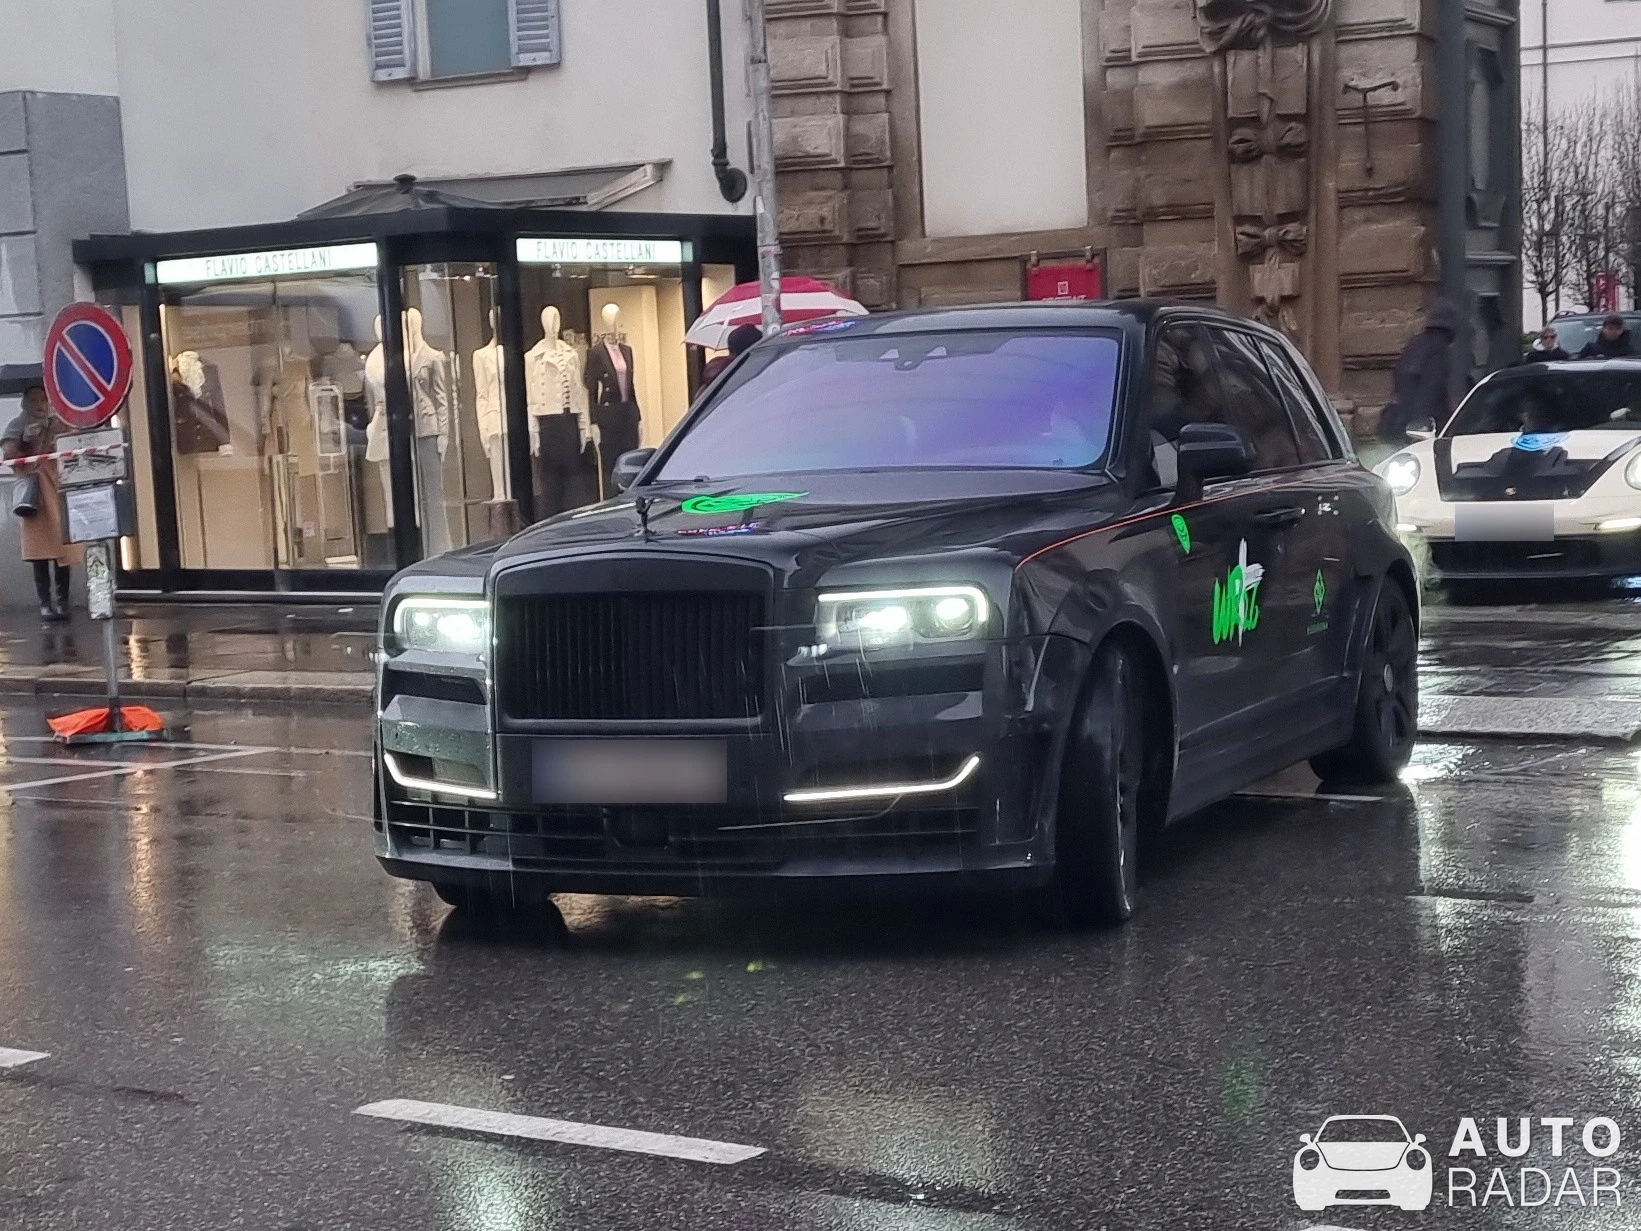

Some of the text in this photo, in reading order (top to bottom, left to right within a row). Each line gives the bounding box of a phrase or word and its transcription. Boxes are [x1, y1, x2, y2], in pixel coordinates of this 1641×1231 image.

[536, 241, 656, 260] FLAVIO CASTELLANI
[205, 250, 331, 276] FLAVIO CASTELLANI
